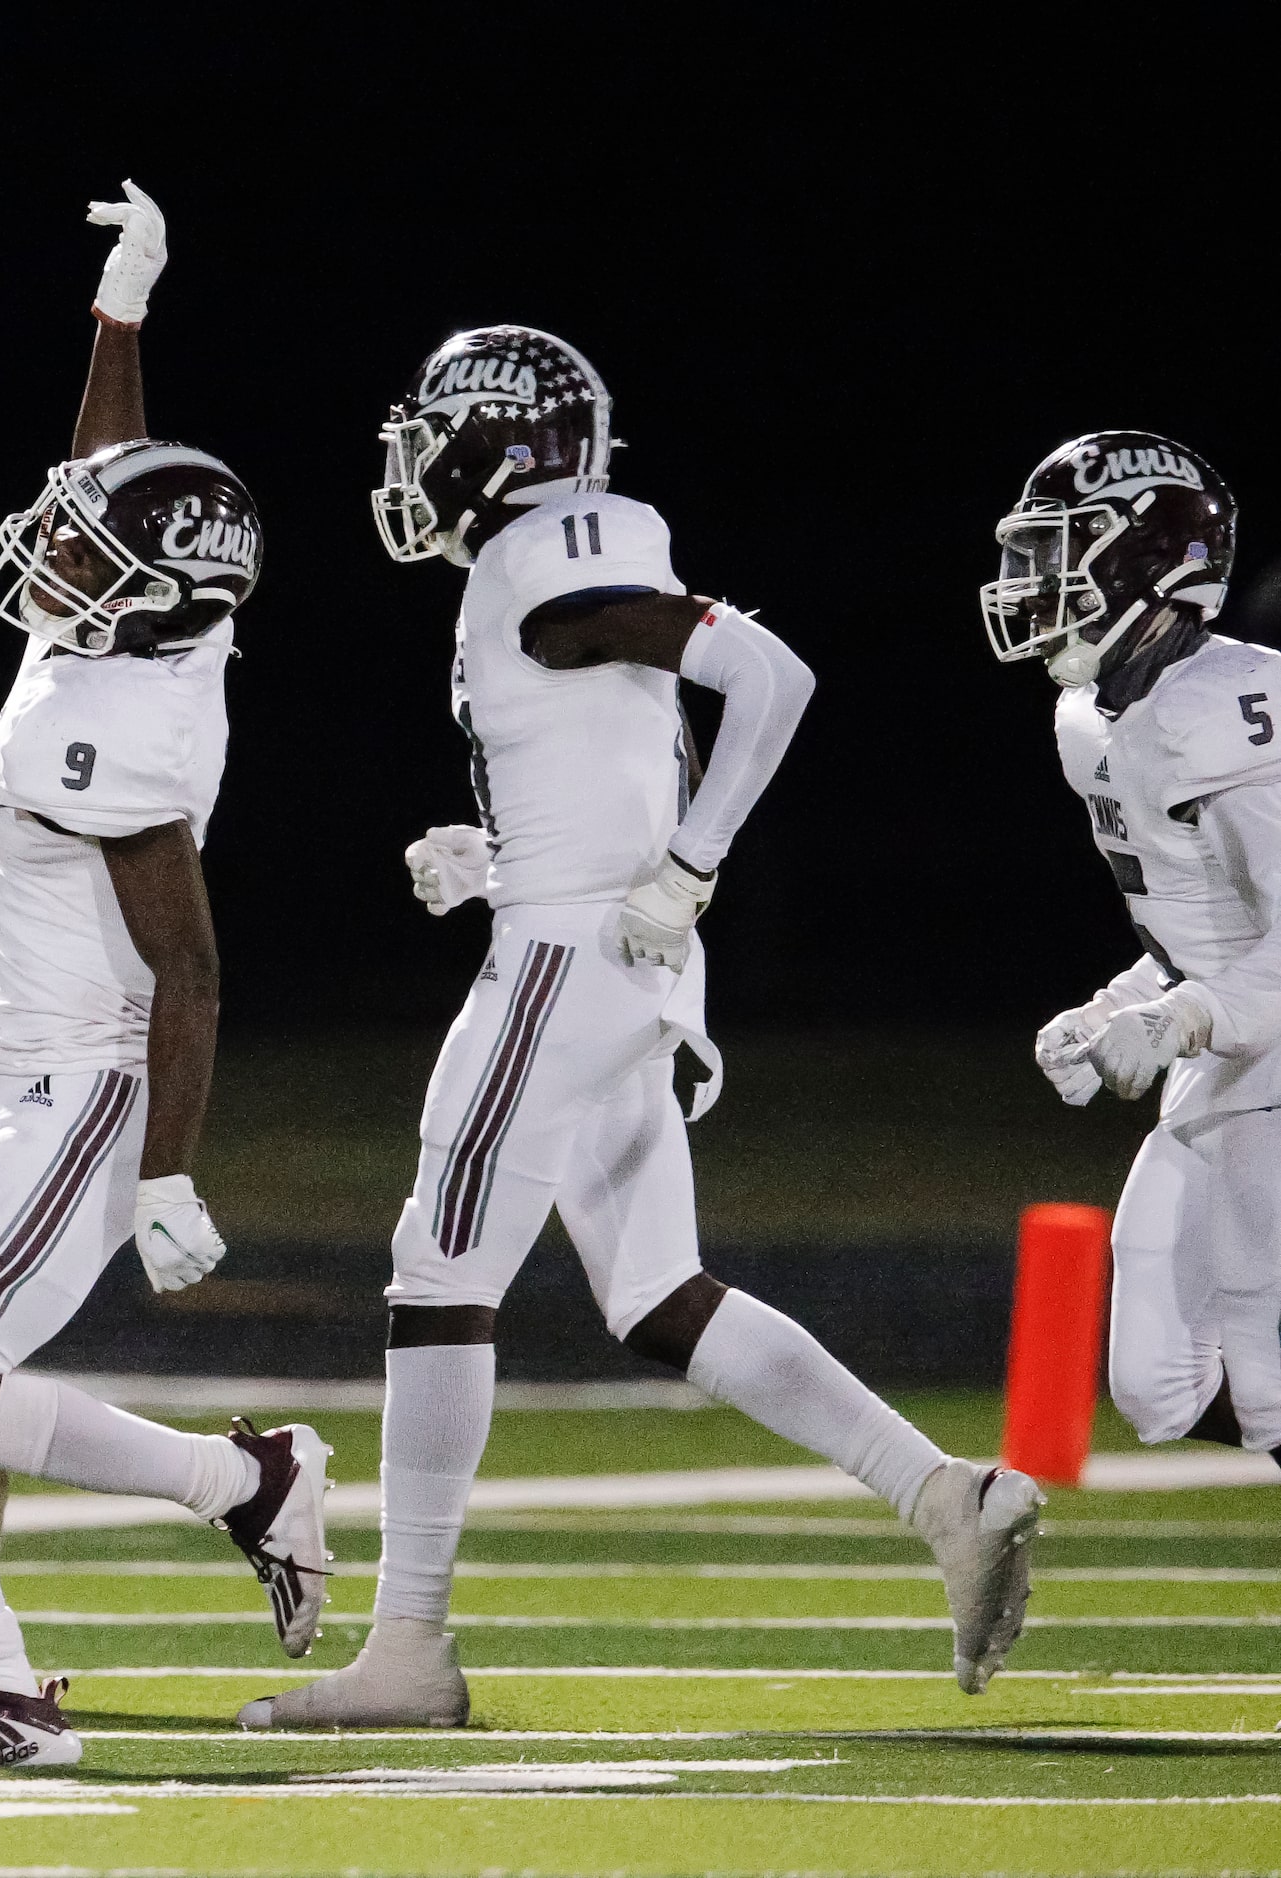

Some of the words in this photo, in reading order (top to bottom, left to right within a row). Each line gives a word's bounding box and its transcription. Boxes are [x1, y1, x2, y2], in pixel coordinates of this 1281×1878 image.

[418, 351, 537, 405] Ennis
[1070, 444, 1204, 493] Ennis
[561, 512, 602, 559] 11
[1237, 692, 1275, 747] 5
[60, 741, 97, 791] 9
[19, 1092, 55, 1107] adidas
